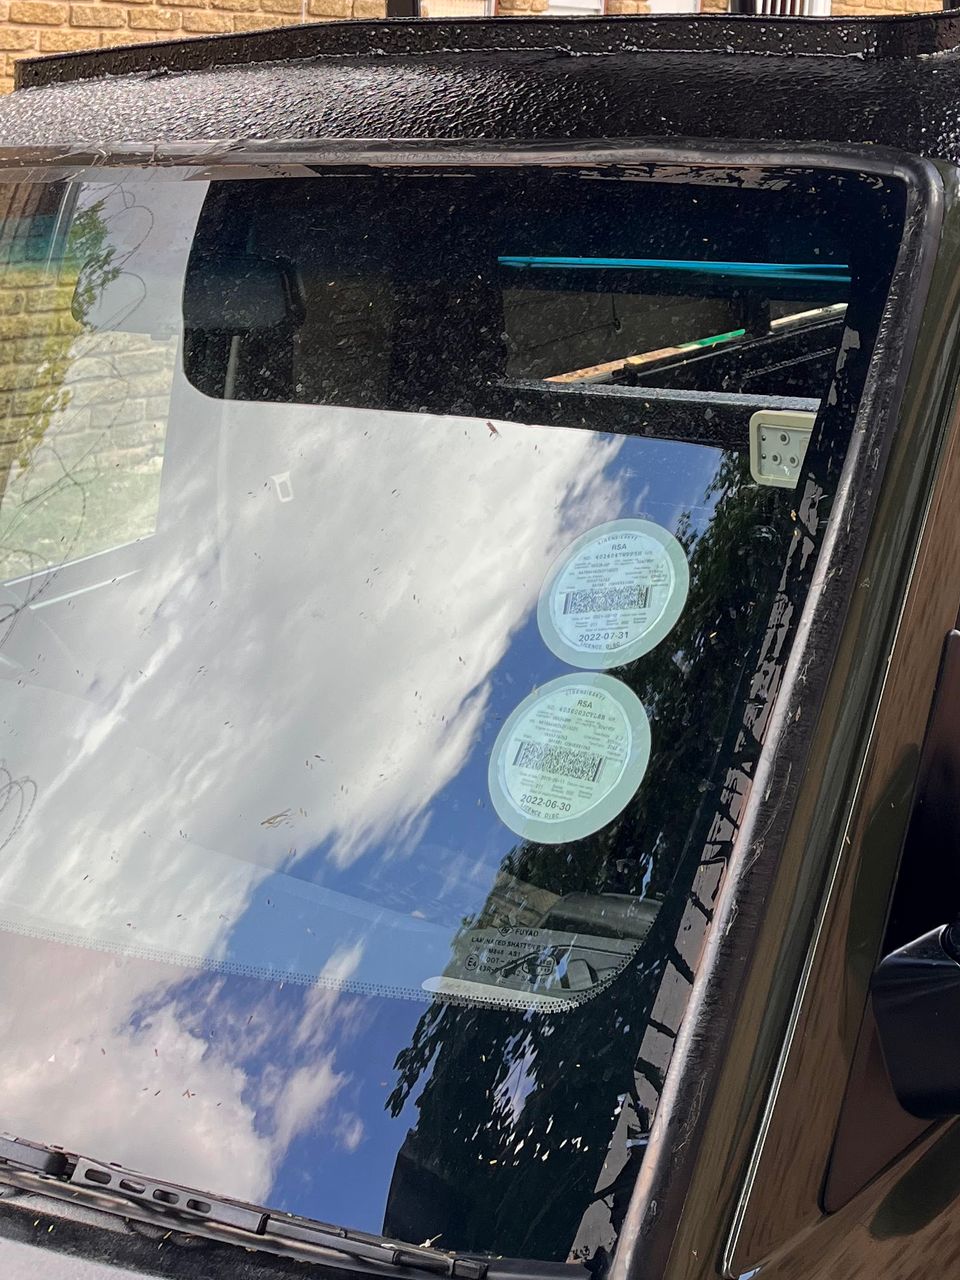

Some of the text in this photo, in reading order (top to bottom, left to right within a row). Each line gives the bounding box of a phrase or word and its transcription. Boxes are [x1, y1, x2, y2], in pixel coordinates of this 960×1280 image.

[578, 631, 629, 642] 2022-07-31
[577, 699, 593, 708] RSA
[520, 794, 571, 812] 2022-06-30
